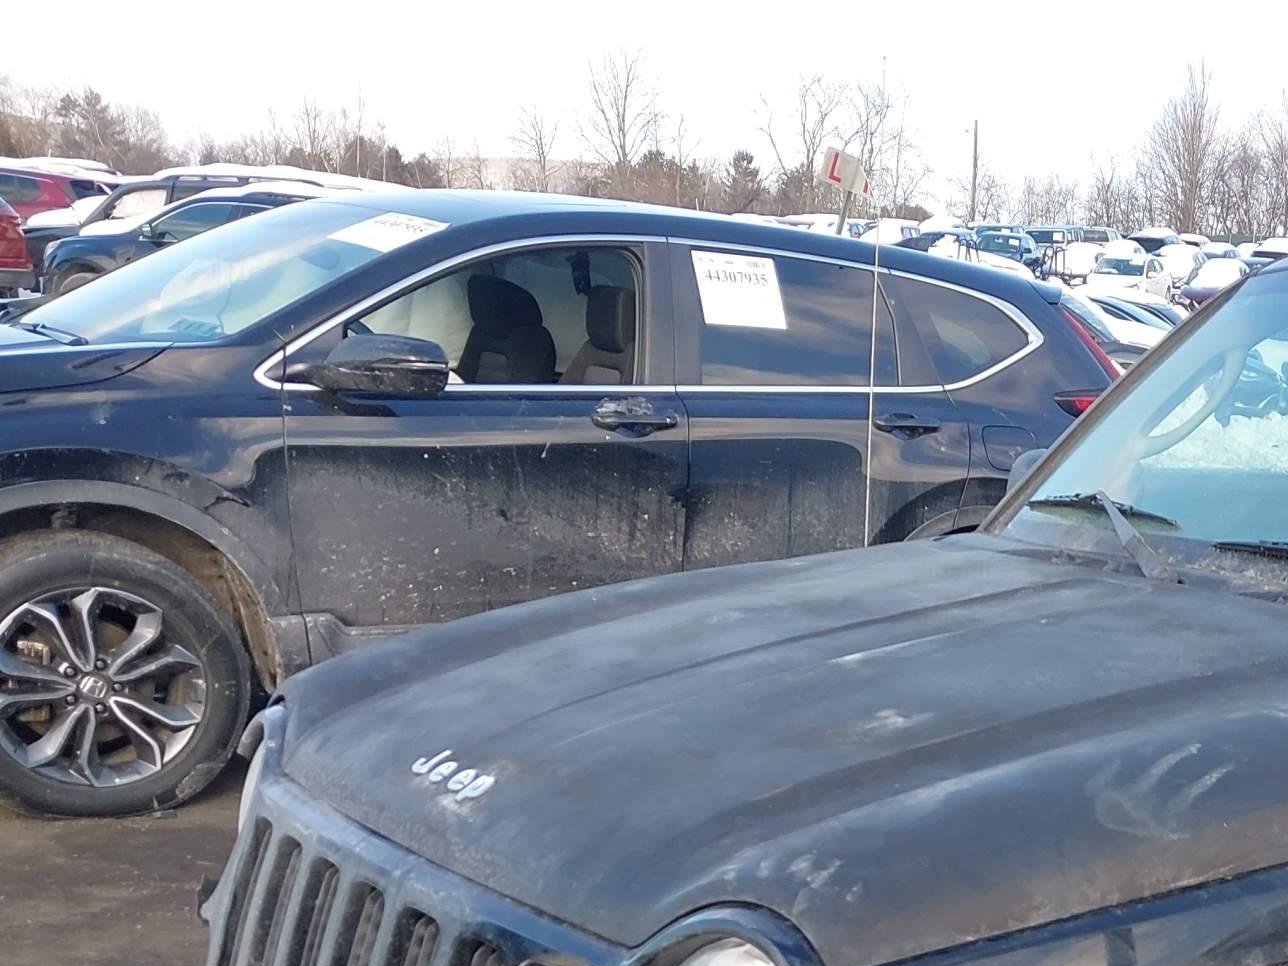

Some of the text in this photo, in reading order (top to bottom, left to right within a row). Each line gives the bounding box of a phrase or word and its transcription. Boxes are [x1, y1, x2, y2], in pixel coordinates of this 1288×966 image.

[828, 151, 842, 184] L
[705, 268, 769, 287] 44307935
[411, 749, 496, 802] Jeep
